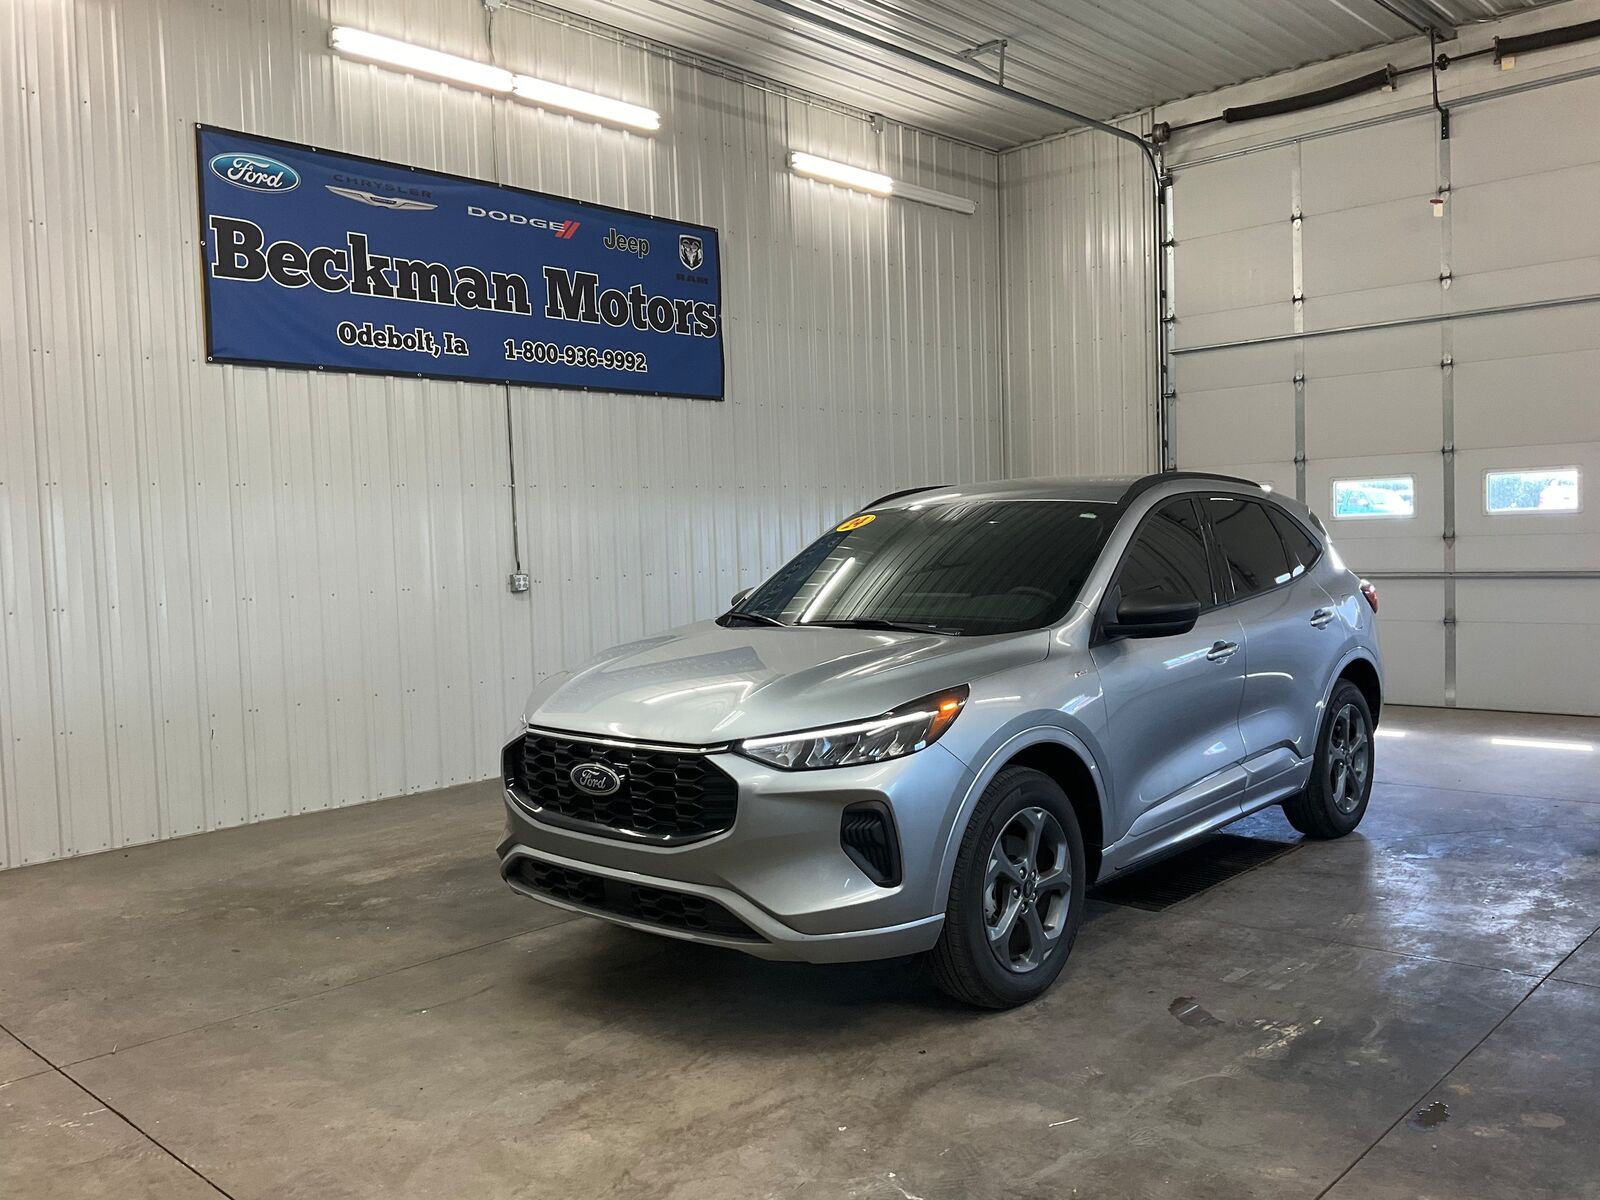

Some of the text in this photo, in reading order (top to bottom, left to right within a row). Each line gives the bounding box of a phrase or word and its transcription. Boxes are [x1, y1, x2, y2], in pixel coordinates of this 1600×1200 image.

[227, 157, 283, 189] Ford
[332, 173, 433, 199] CHRYSLER
[467, 206, 566, 232] DODGE
[602, 228, 650, 259] Jeep
[208, 214, 718, 338] Beckman Motors
[336, 321, 469, 358] Odebolt, Ia
[504, 338, 648, 372] 1-800-936-9992
[580, 769, 607, 789] Ford
